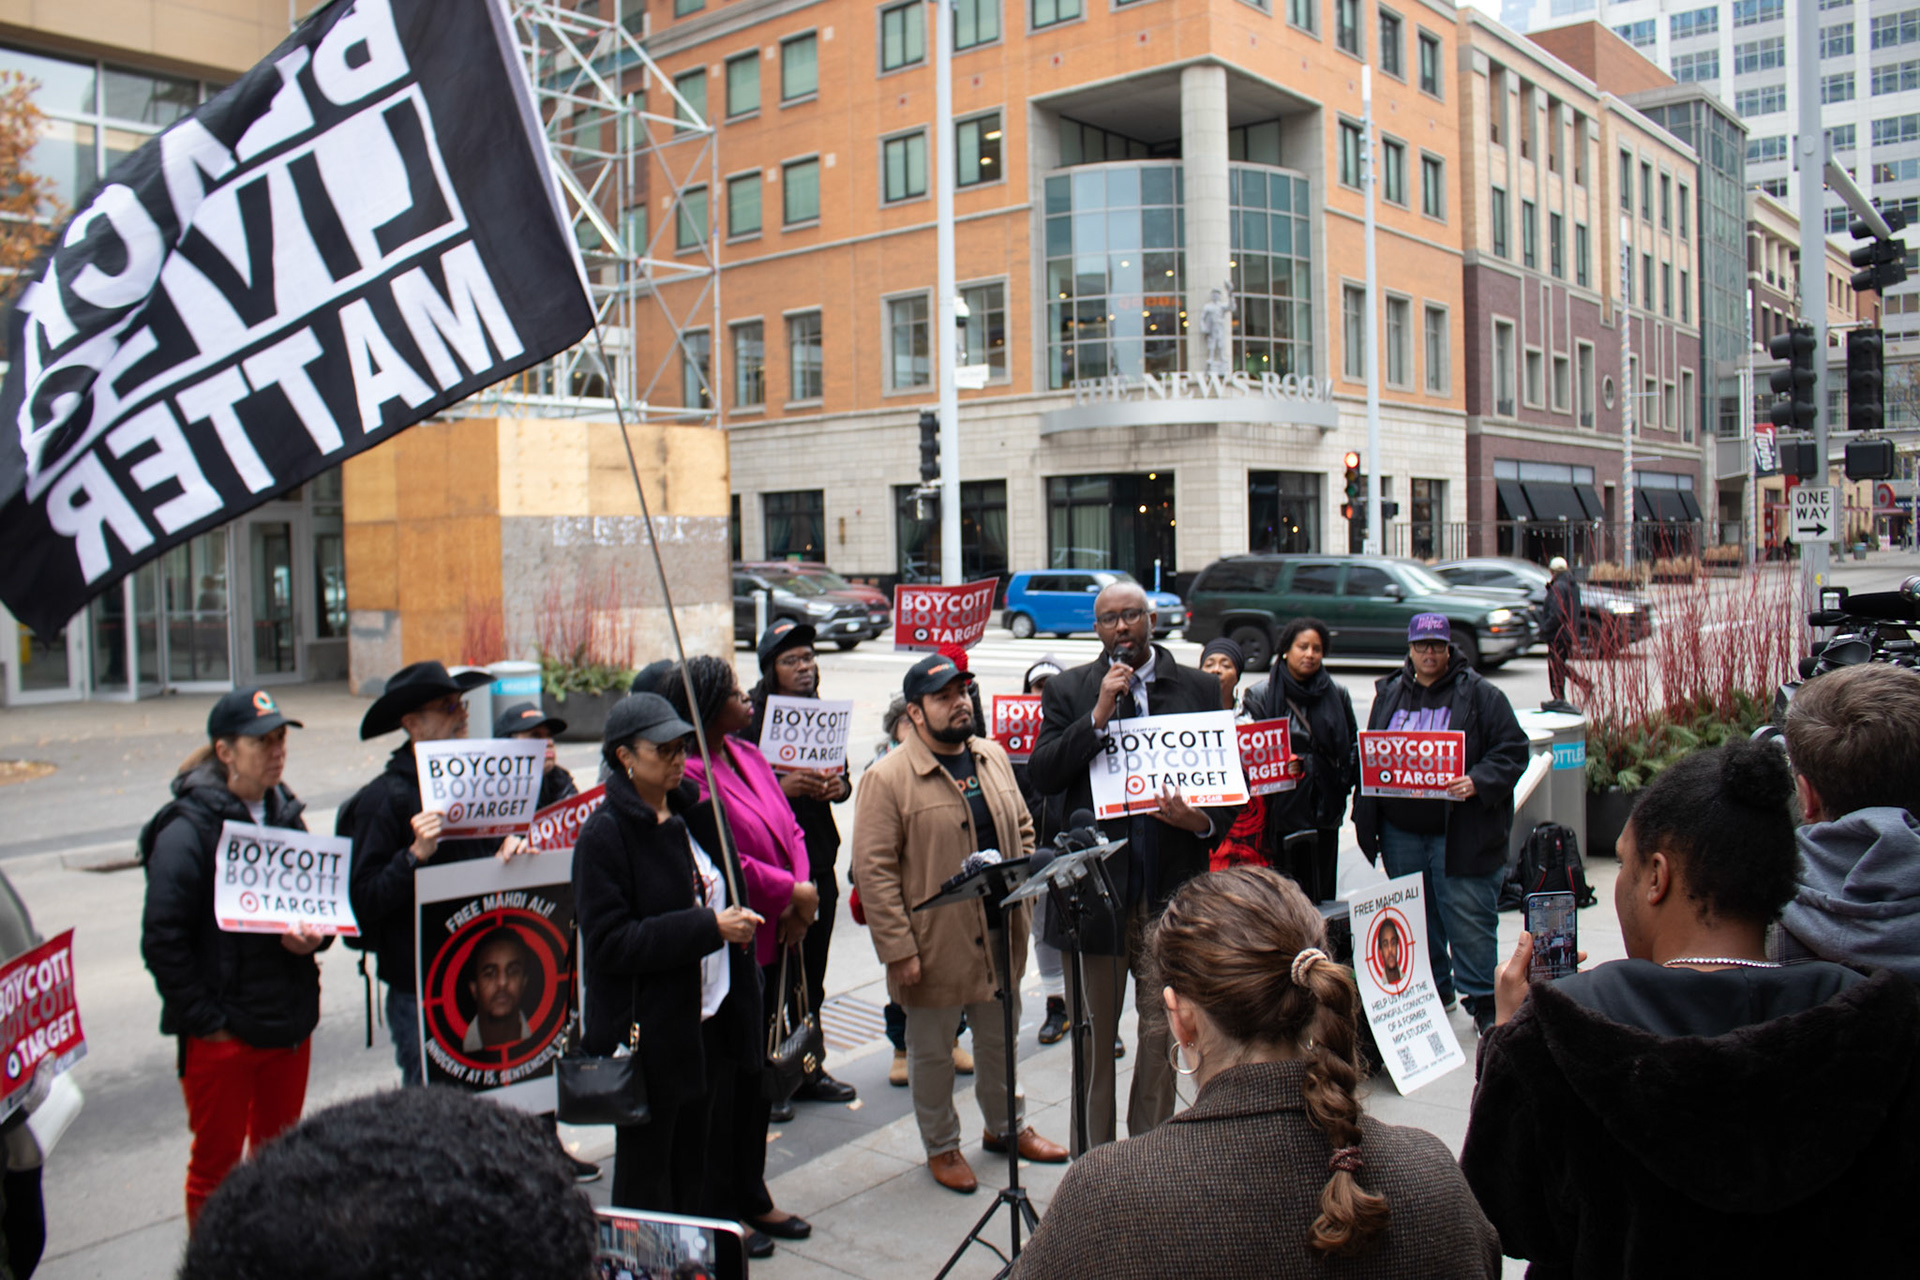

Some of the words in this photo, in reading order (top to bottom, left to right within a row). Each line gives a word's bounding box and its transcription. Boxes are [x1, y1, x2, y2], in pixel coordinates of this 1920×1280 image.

[1070, 374, 1131, 405] THE
[1143, 371, 1250, 399] NEWS
[1797, 491, 1829, 505] ONE
[1796, 507, 1830, 520] WAY
[901, 589, 990, 612] BOYCOTT
[901, 604, 986, 627] BOYCOTT
[931, 621, 984, 643] TARGET
[773, 709, 848, 728] BOYCOTT
[770, 726, 846, 744] BOYCOTT
[1105, 730, 1224, 755] BOYCOTT
[799, 746, 843, 760] TARGET
[1364, 740, 1457, 757] BOYCOTT
[429, 755, 536, 778] BOYCOTT
[1107, 749, 1227, 774] BOYCOTT
[1248, 761, 1285, 781] RGET
[1366, 754, 1457, 771] BOYCOTT
[433, 776, 534, 800] BOYCOTT
[1148, 771, 1227, 789] TARGET
[466, 799, 528, 819] TARGET
[227, 840, 341, 873] BOYCOTT
[226, 864, 340, 895] BOYCOTT
[261, 894, 337, 916] TARGET
[445, 900, 482, 934] FREE
[483, 891, 528, 912] MAHDI
[1353, 900, 1374, 918] FREE
[1375, 890, 1403, 910] MAHDI
[1405, 886, 1419, 901] ALI
[17, 1009, 75, 1068] TARGET
[465, 1070, 482, 1084] AT
